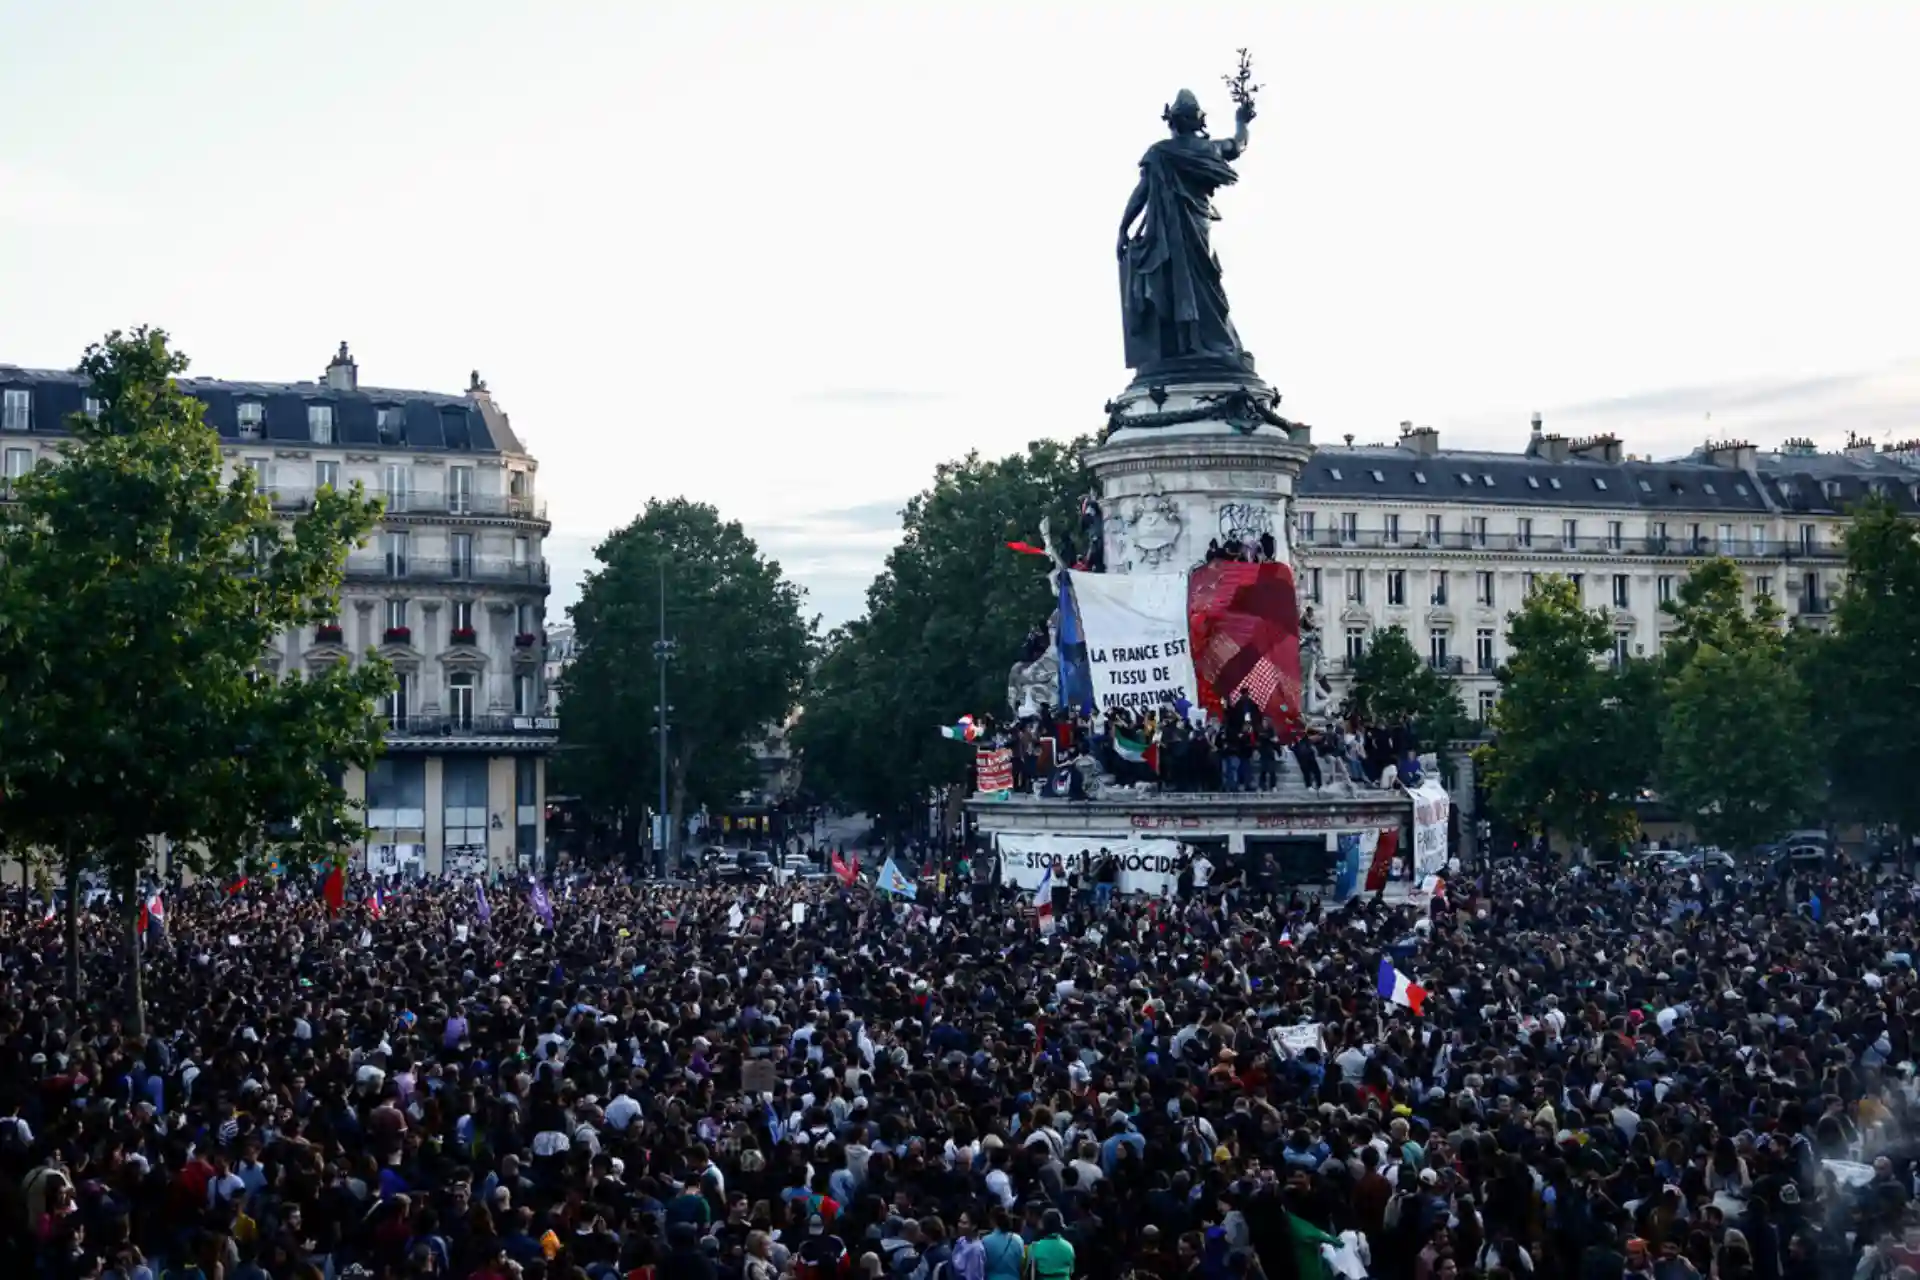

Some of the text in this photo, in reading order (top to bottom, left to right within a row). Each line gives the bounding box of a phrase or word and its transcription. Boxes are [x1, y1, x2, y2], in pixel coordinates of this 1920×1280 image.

[1091, 639, 1186, 662] LA FRANCE EST
[1109, 667, 1170, 684] TISSU DE
